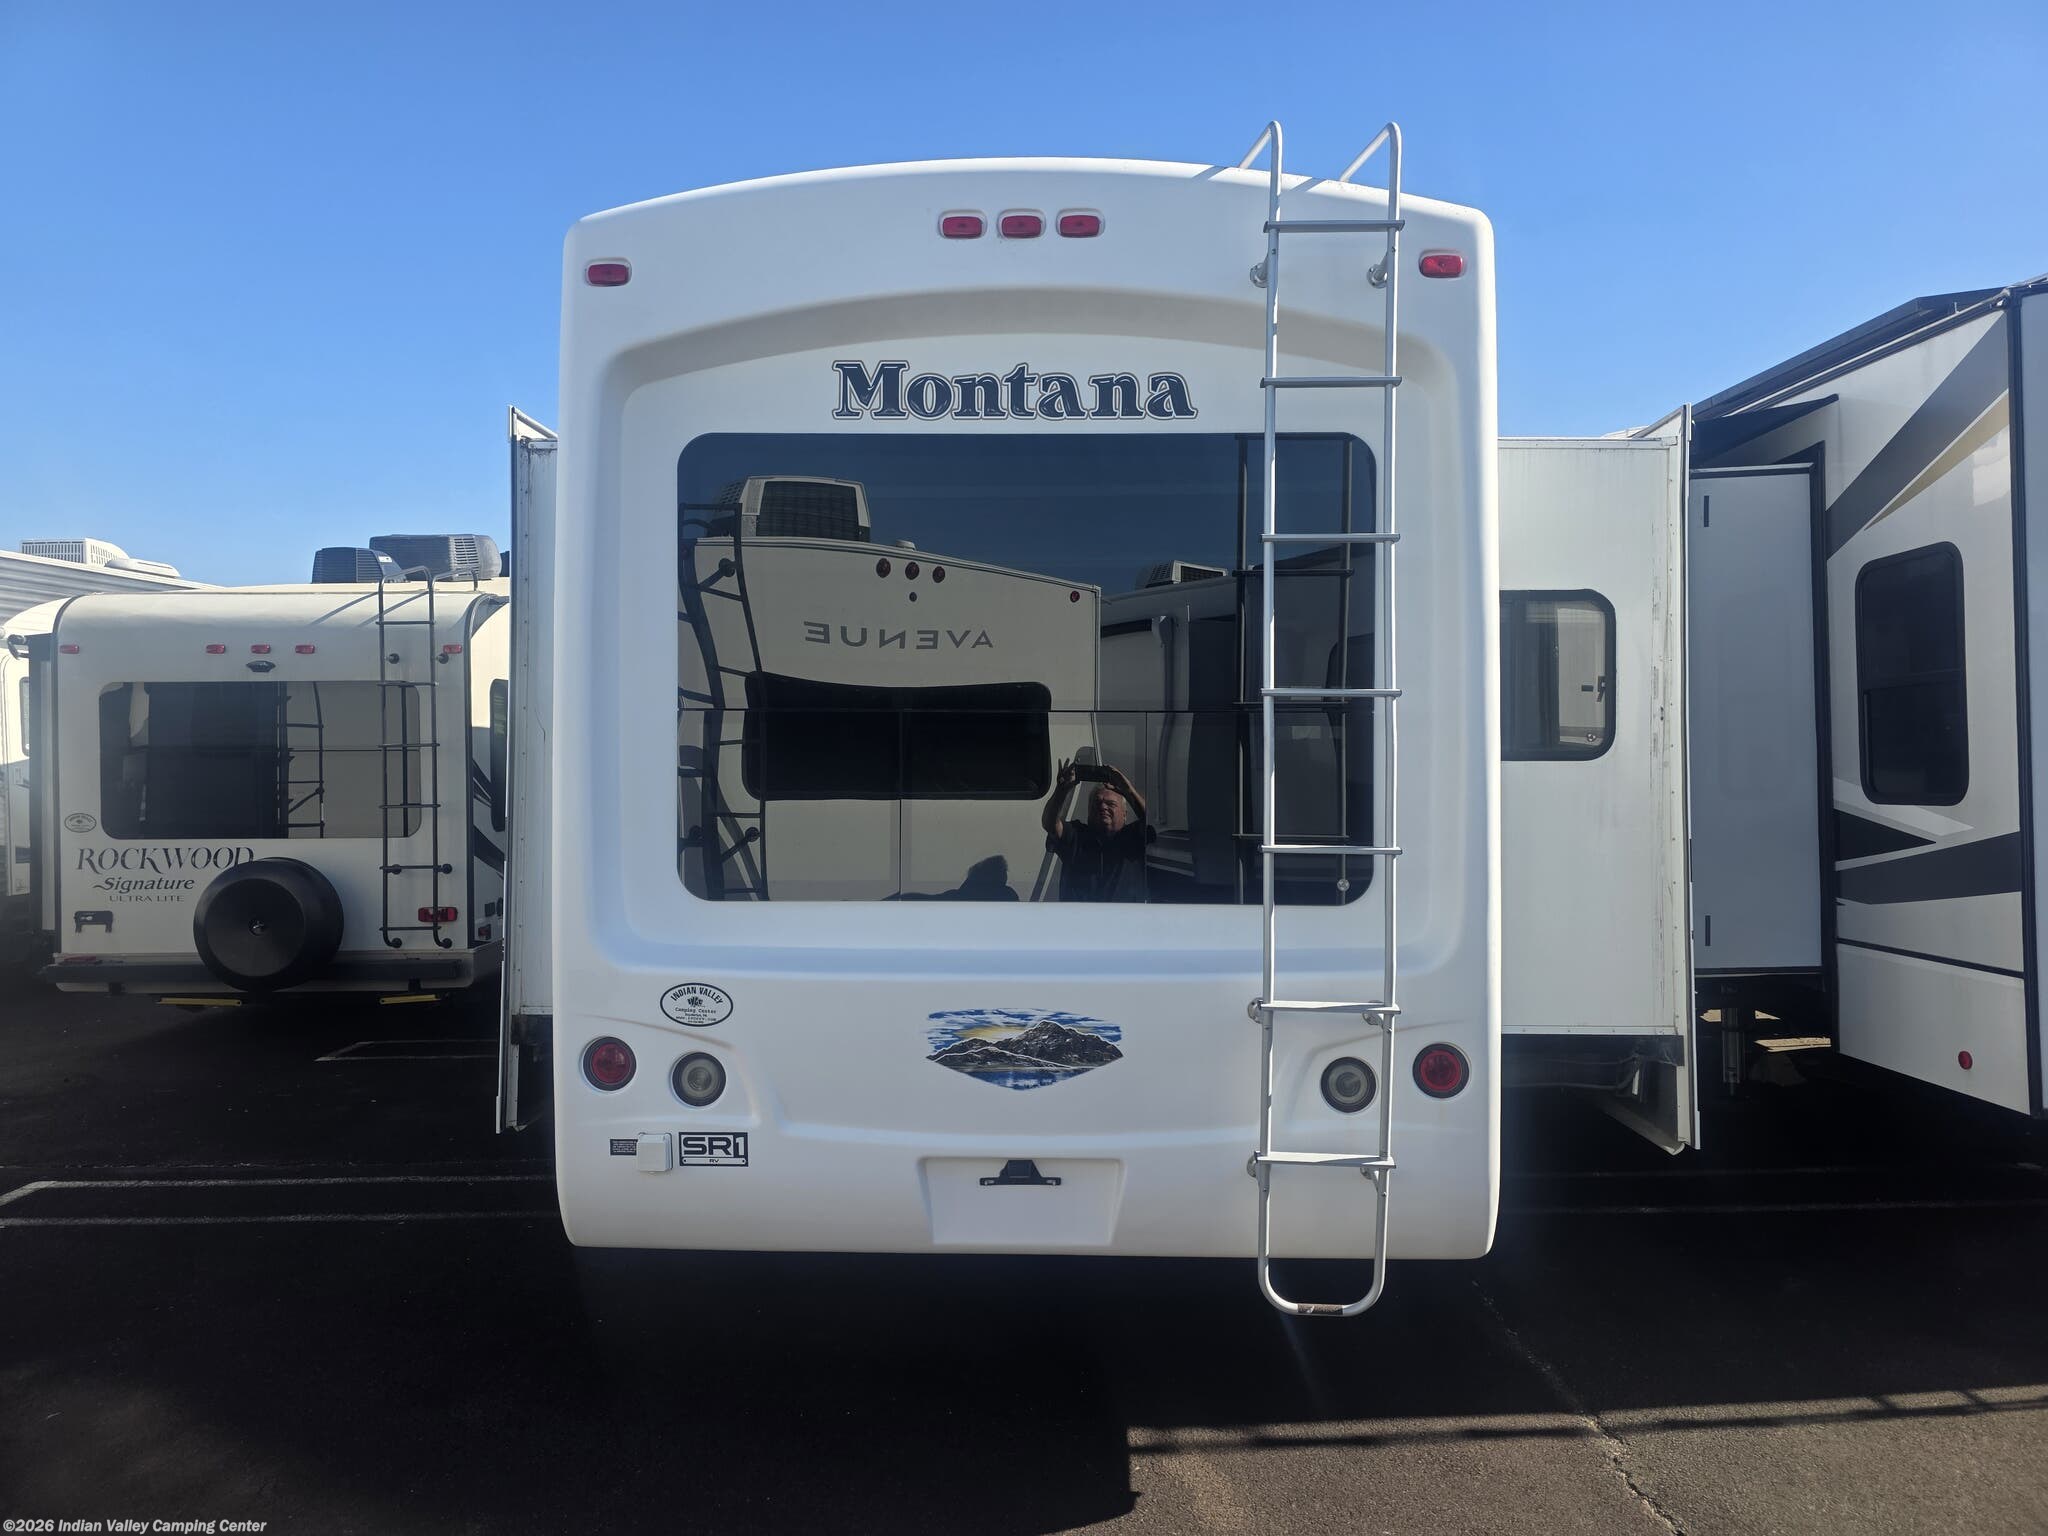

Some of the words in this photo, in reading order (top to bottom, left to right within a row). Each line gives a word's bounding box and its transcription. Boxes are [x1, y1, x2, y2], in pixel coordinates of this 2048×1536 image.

[832, 360, 1198, 420] Montana
[77, 847, 254, 874] ROCKWOOD
[93, 876, 195, 894] Signature
[670, 986, 697, 1002] INDIAN
[699, 986, 723, 1004] VALLEY
[683, 1136, 746, 1156] SR1
